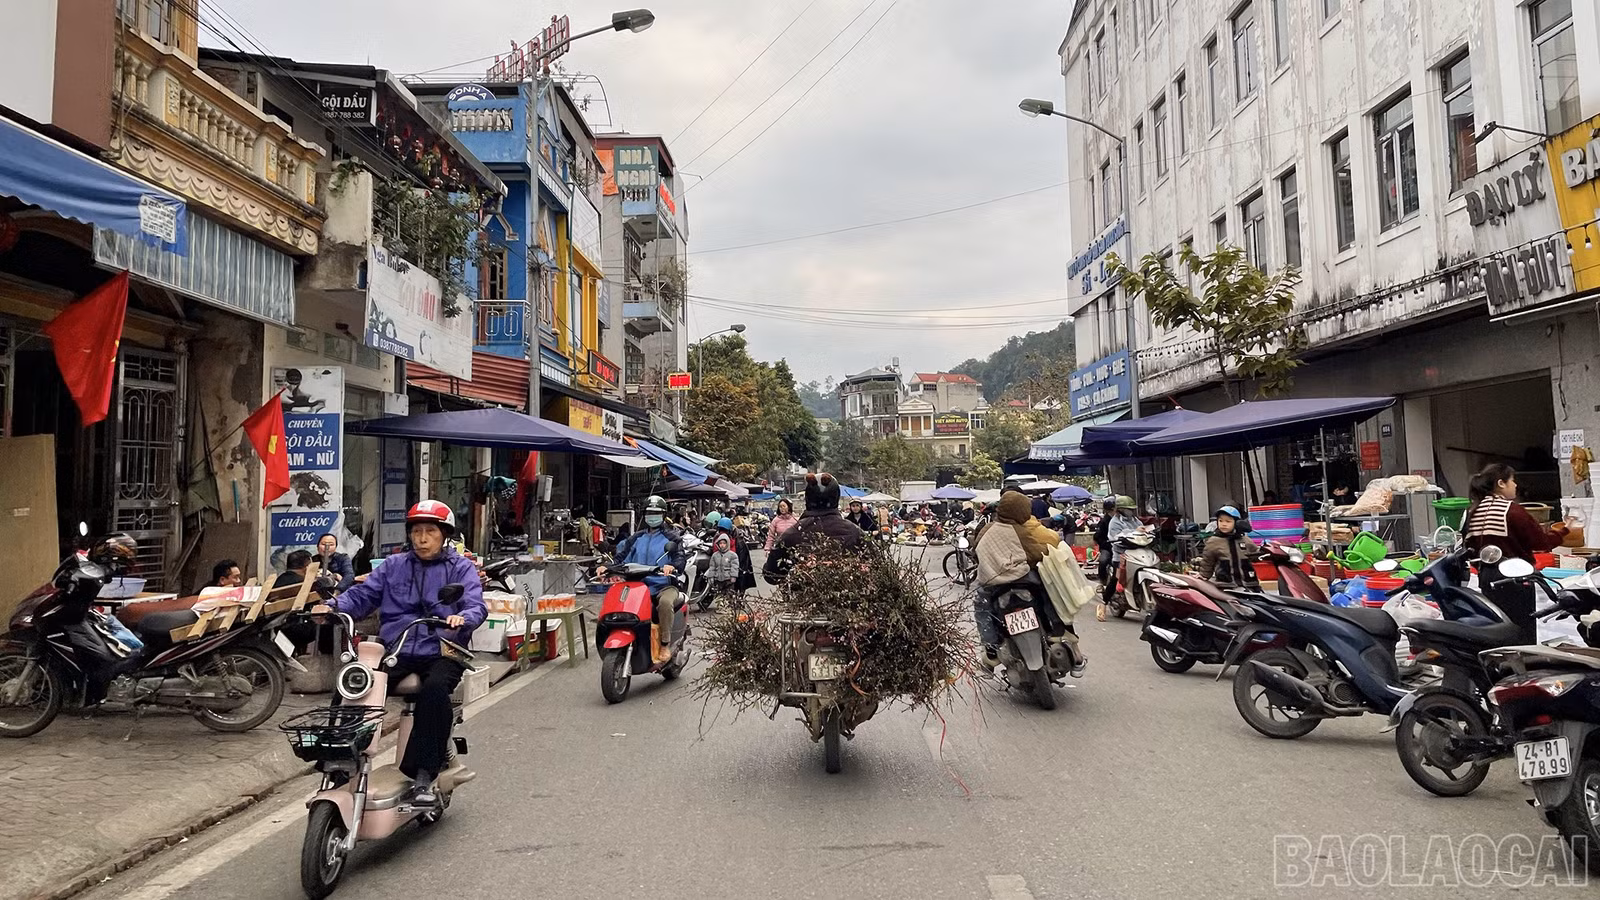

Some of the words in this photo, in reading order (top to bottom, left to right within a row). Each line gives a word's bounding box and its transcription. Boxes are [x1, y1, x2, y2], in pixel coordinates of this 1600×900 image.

[322, 94, 341, 110] GỘI
[343, 92, 367, 108] ĐẦU
[620, 146, 653, 165] NHÀ
[617, 165, 656, 186] NGHỈ
[1464, 175, 1515, 227] ĐẠI
[1511, 148, 1546, 207] LÝ
[380, 338, 408, 357] 0387788382
[288, 418, 324, 429] CHUYÊN
[305, 431, 333, 448] ĐẦU
[288, 453, 304, 466] AM
[317, 451, 335, 466] NỮ
[278, 515, 308, 528] CHĂM
[310, 515, 330, 527] SÓC
[295, 531, 315, 542] TÓC
[1523, 741, 1559, 760] 24-B1
[1521, 757, 1567, 777] 478.99
